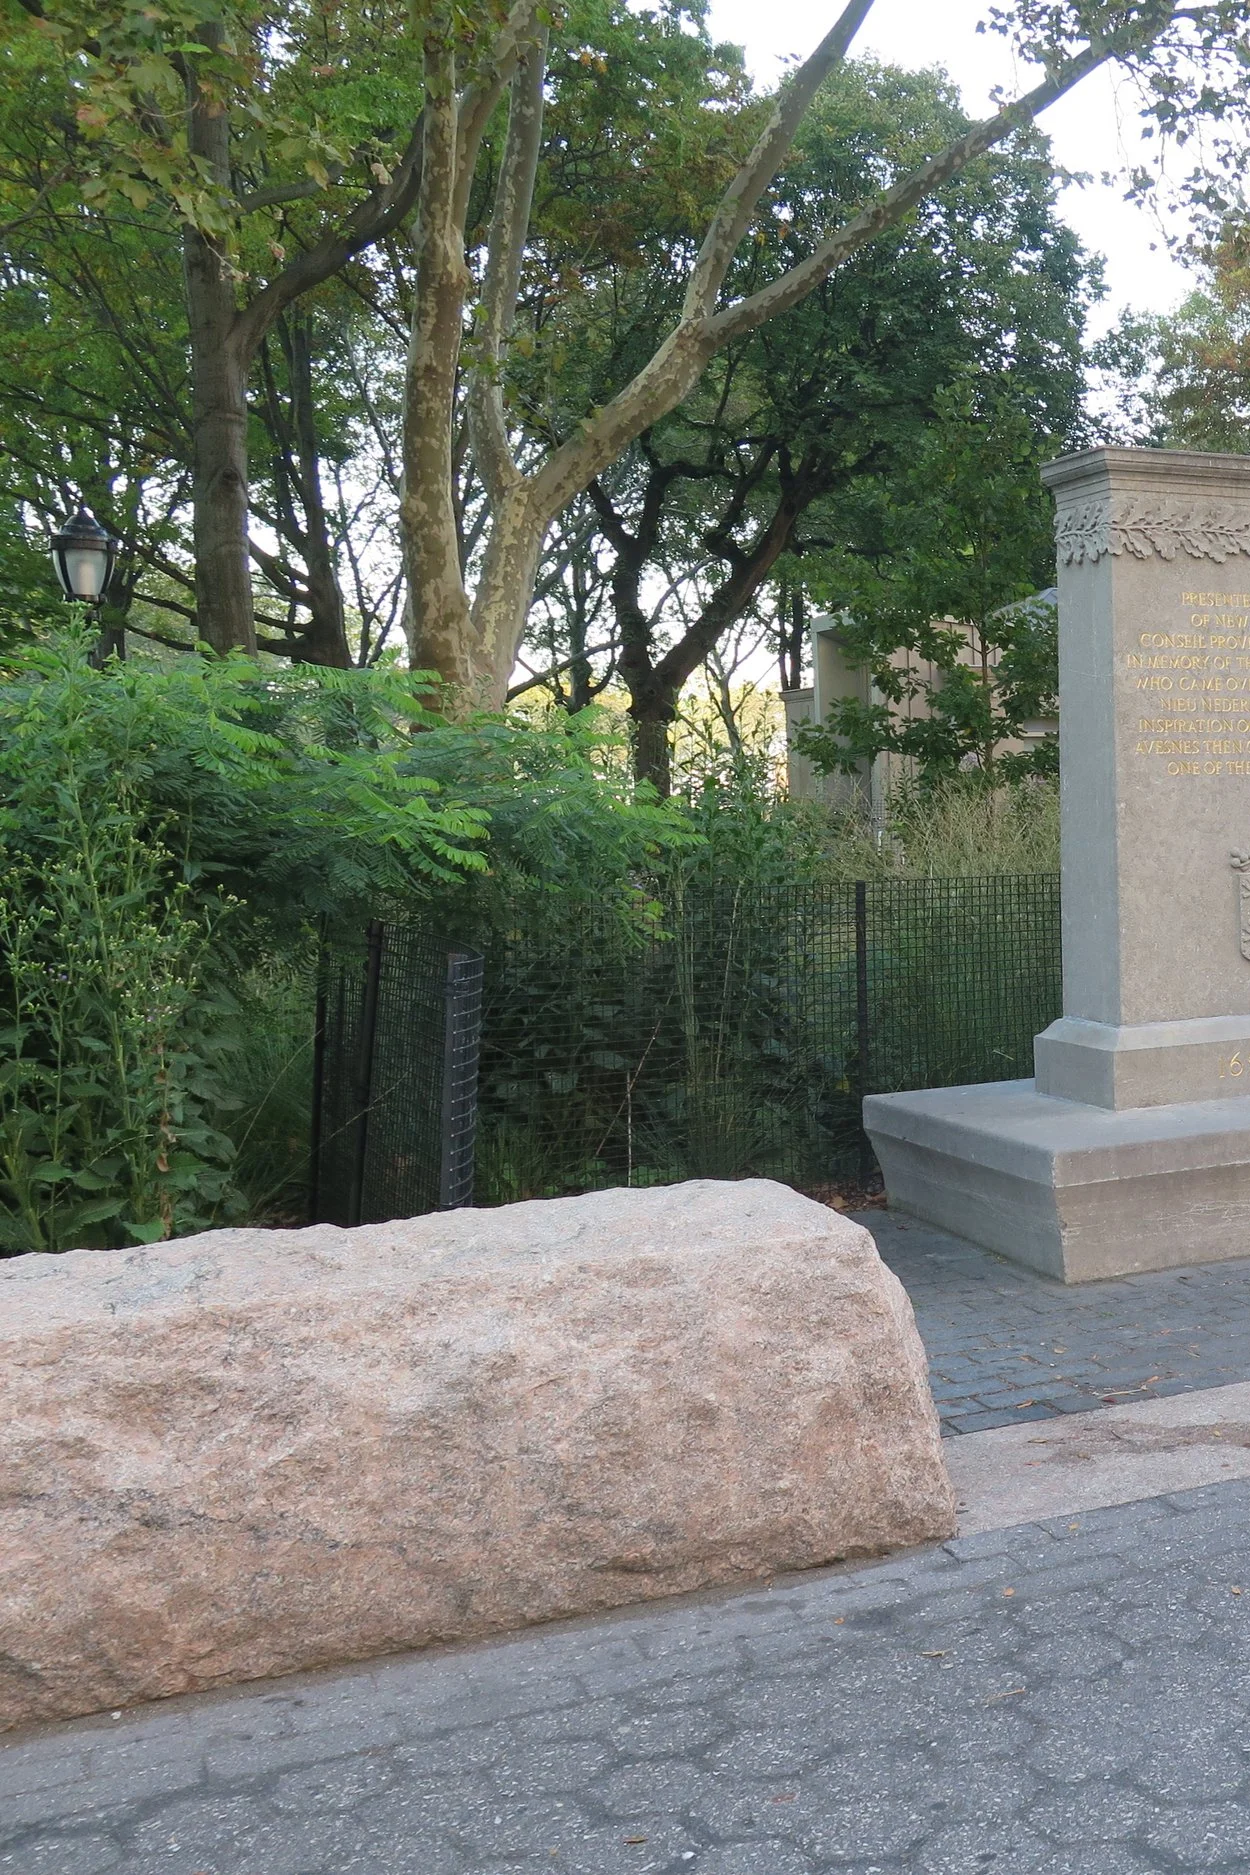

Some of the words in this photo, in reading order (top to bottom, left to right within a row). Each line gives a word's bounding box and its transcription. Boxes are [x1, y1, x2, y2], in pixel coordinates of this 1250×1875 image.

[1191, 613, 1210, 627] OF
[1215, 614, 1250, 629] NEW
[1140, 633, 1206, 649] CONSEIL
[1127, 655, 1143, 669] IN
[1148, 655, 1211, 670] MEMORY
[1213, 656, 1232, 670] OF
[1136, 676, 1173, 691] WHO
[1179, 677, 1222, 691] CAME
[1138, 720, 1235, 733] INSPIRATION
[1135, 741, 1200, 755] AVESNES
[1202, 740, 1244, 754] THEN
[1167, 762, 1200, 776] ONE
[1204, 761, 1223, 775] OF
